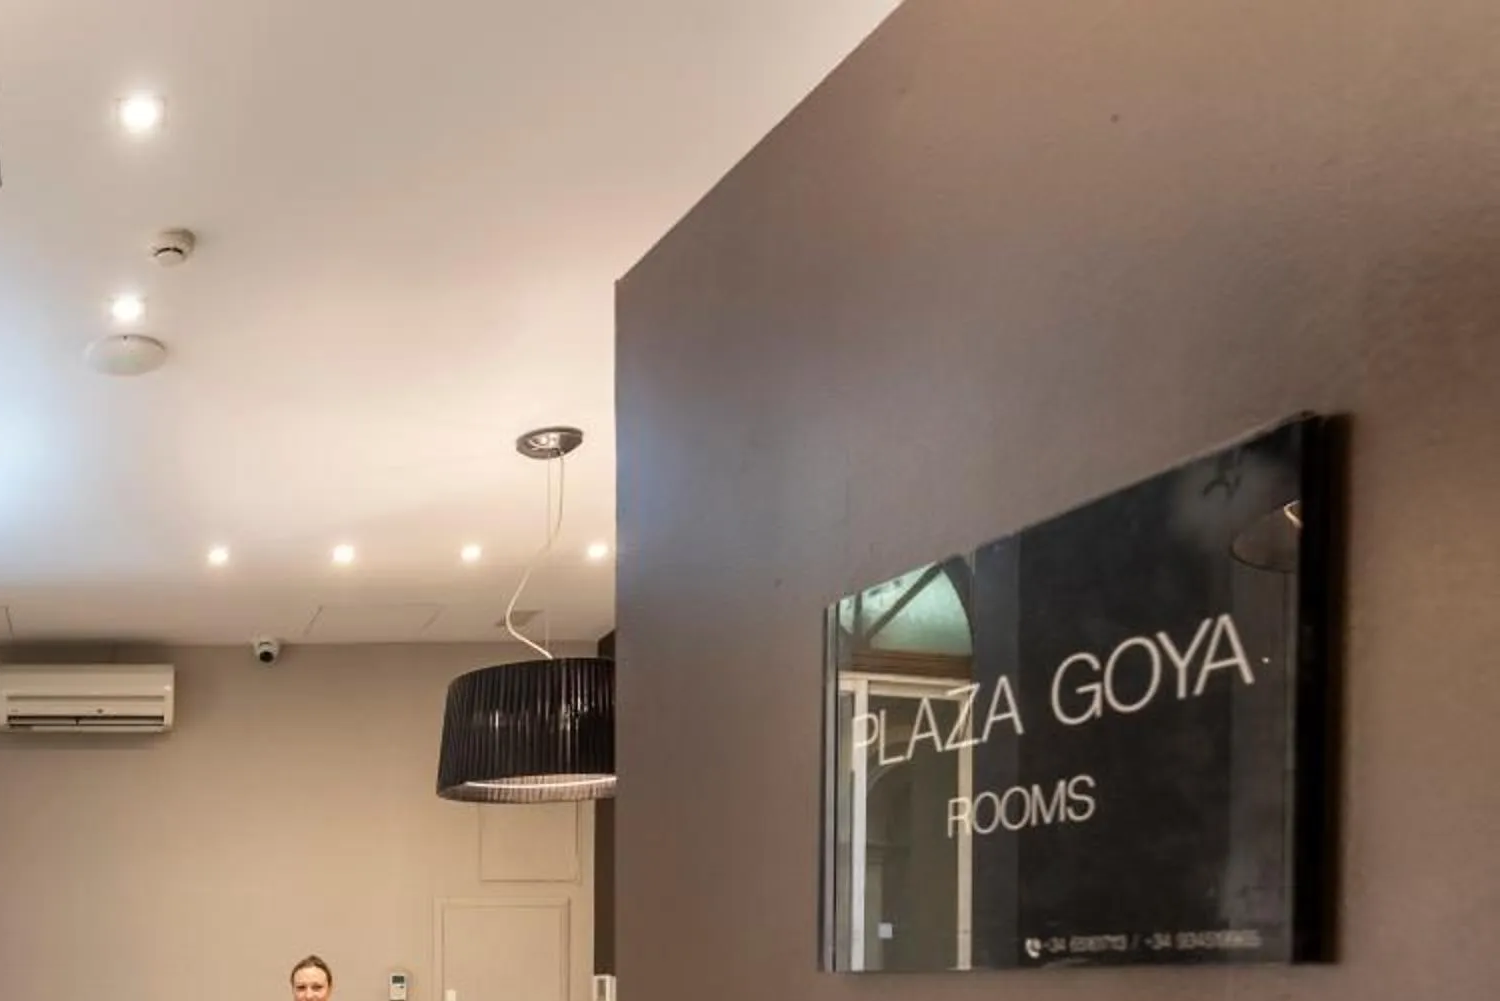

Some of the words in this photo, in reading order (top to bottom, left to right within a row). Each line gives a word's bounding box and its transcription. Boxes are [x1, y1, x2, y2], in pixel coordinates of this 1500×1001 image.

[852, 674, 1025, 772] PLAZA
[1050, 612, 1256, 728] GOYA
[947, 775, 1097, 839] ROOMS
